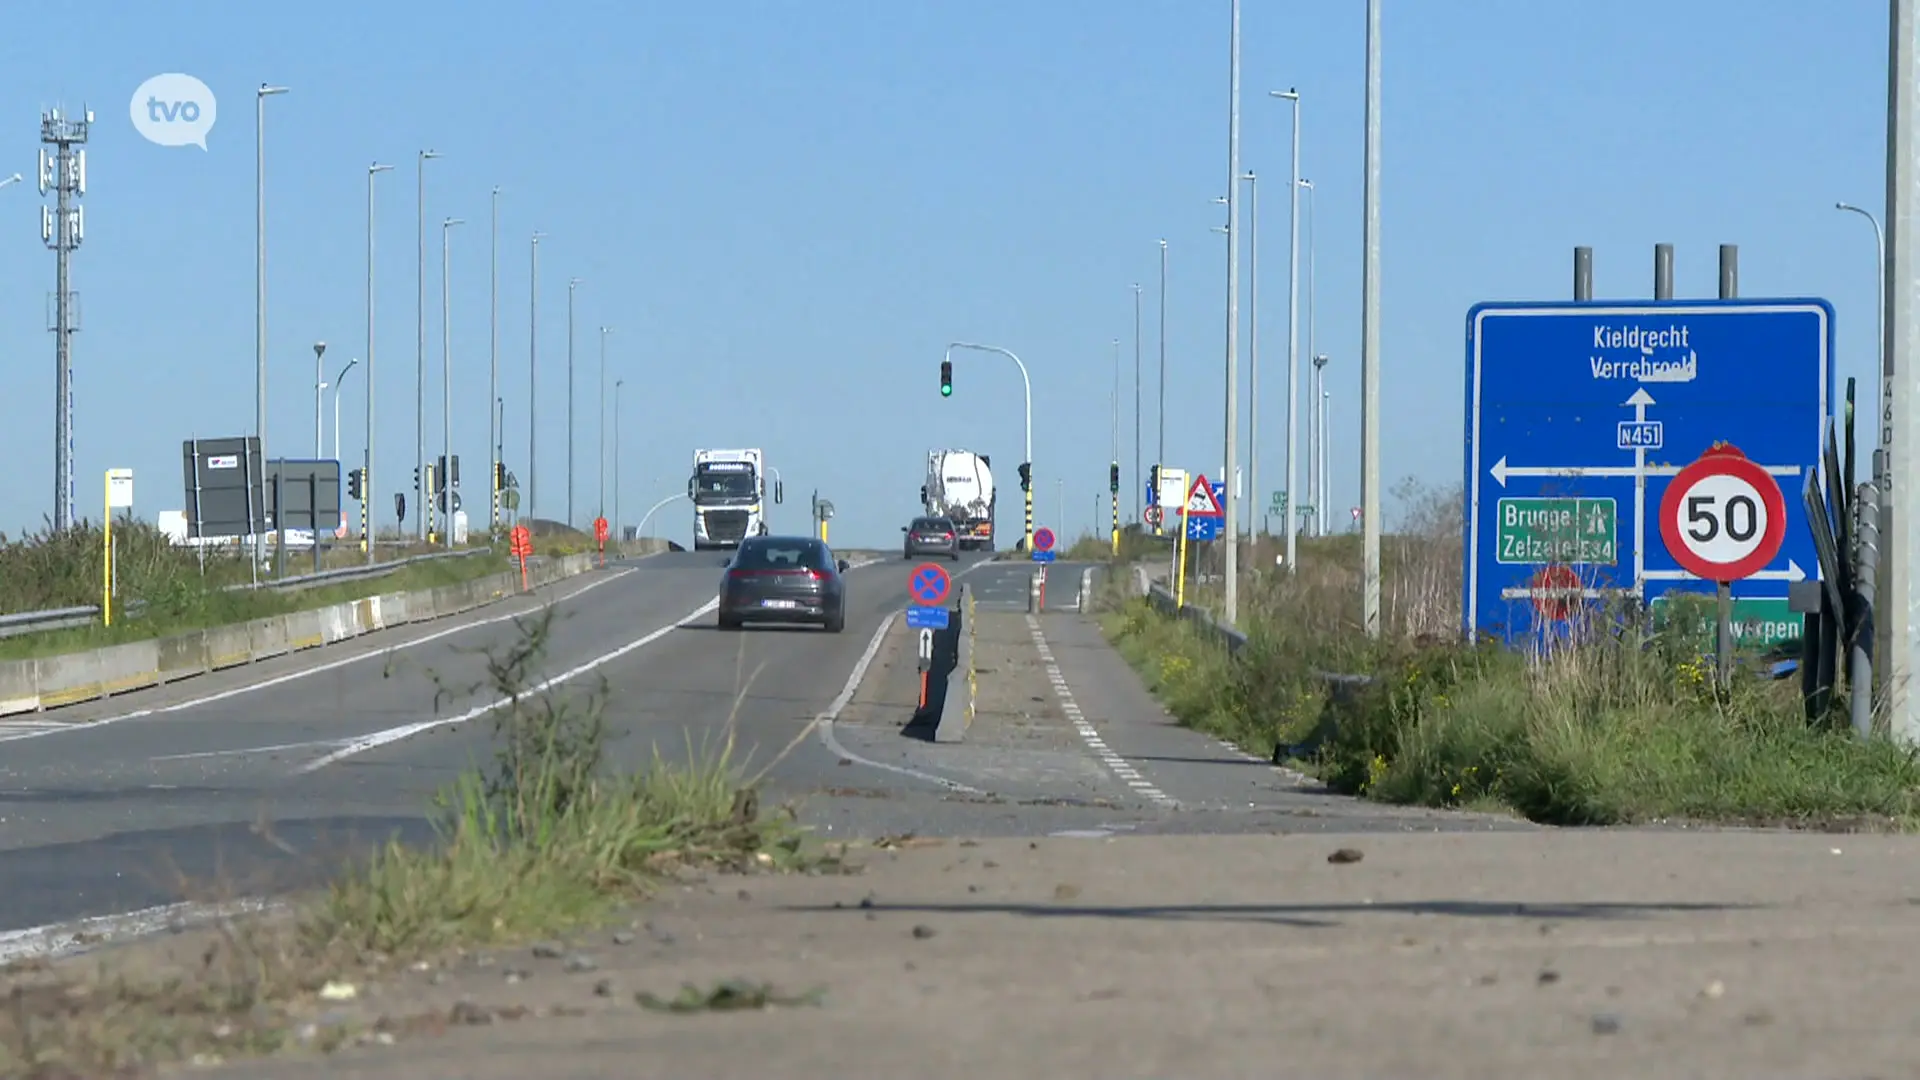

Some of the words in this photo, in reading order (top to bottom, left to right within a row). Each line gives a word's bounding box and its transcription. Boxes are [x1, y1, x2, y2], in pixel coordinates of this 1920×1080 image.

[1594, 324, 1689, 348] Kieldrecht
[1622, 427, 1659, 445] N451
[1505, 504, 1571, 532] Brugge
[1688, 495, 1757, 542] 50
